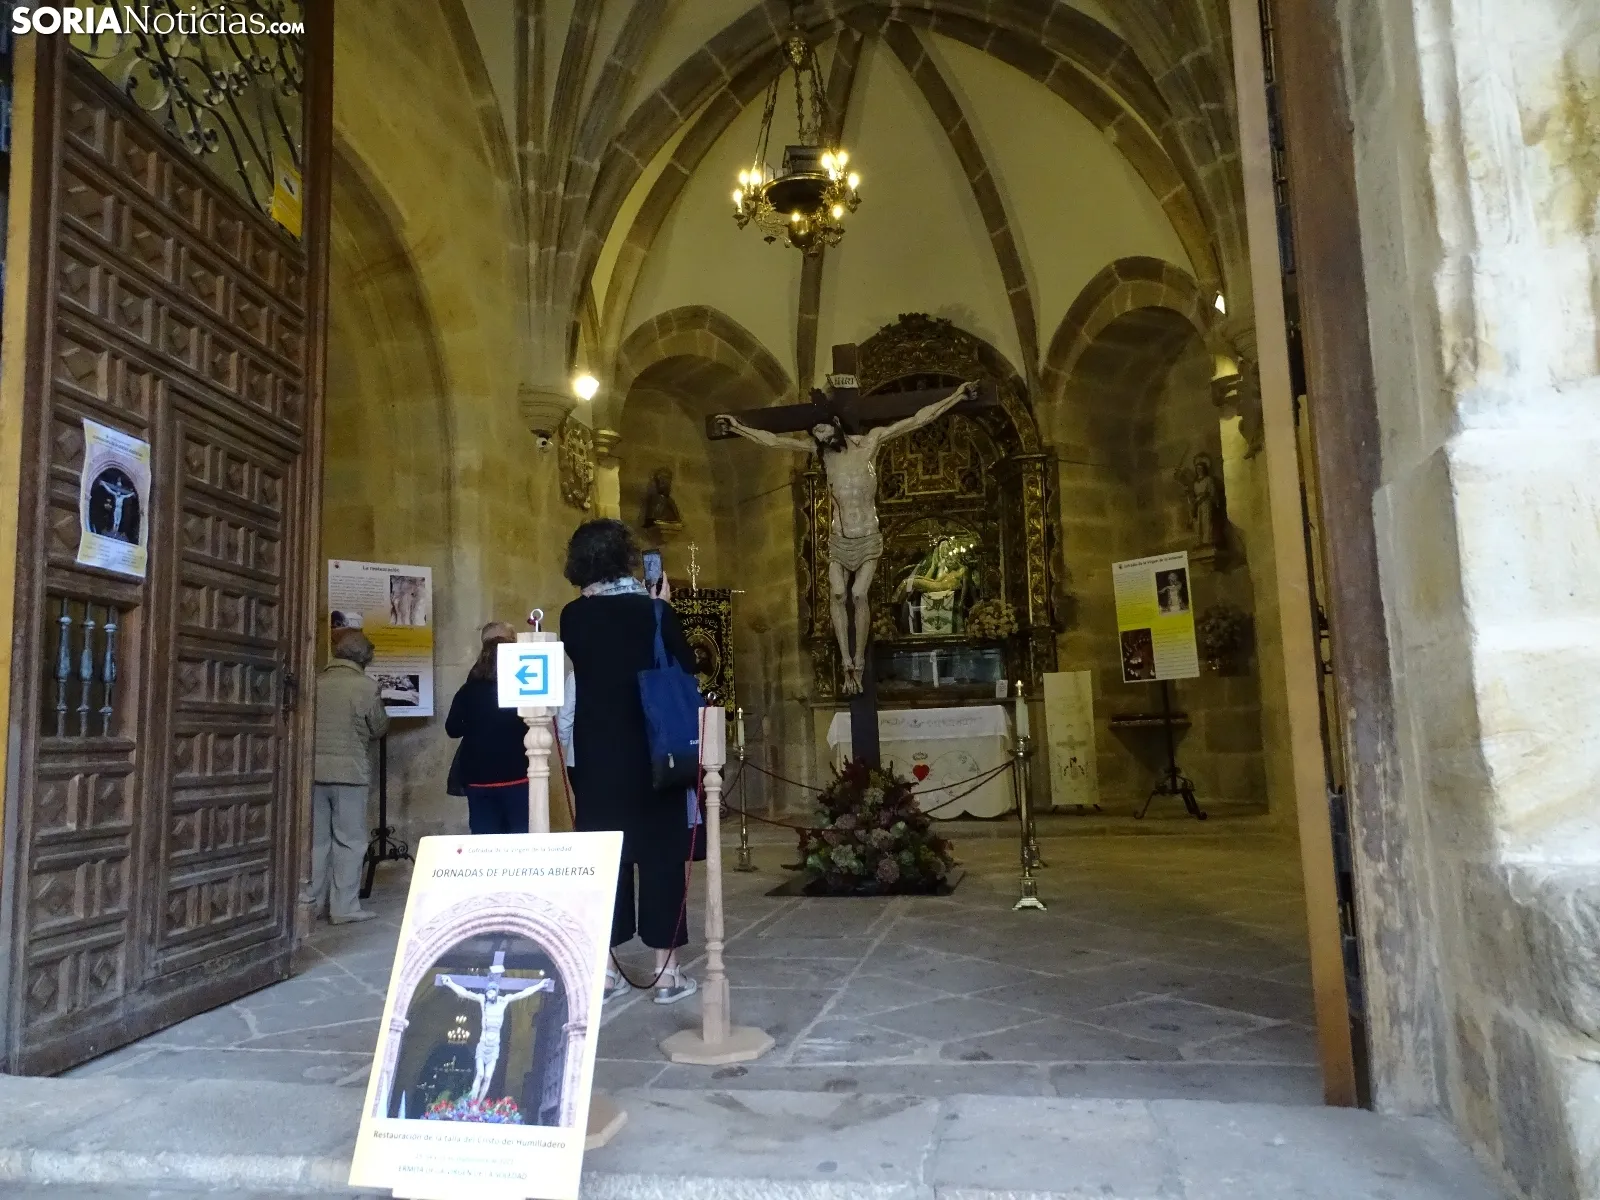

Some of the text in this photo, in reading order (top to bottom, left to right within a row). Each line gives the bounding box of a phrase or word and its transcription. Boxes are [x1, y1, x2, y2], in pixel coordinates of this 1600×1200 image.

[431, 865, 596, 878] JORNADAS DE PUERTAS ABIERTAS
[373, 1130, 566, 1150] Restauración de la talla del Cristo del Humilladero
[398, 1165, 424, 1173] ERMITA
[495, 1171, 528, 1180] SOLEDAD
